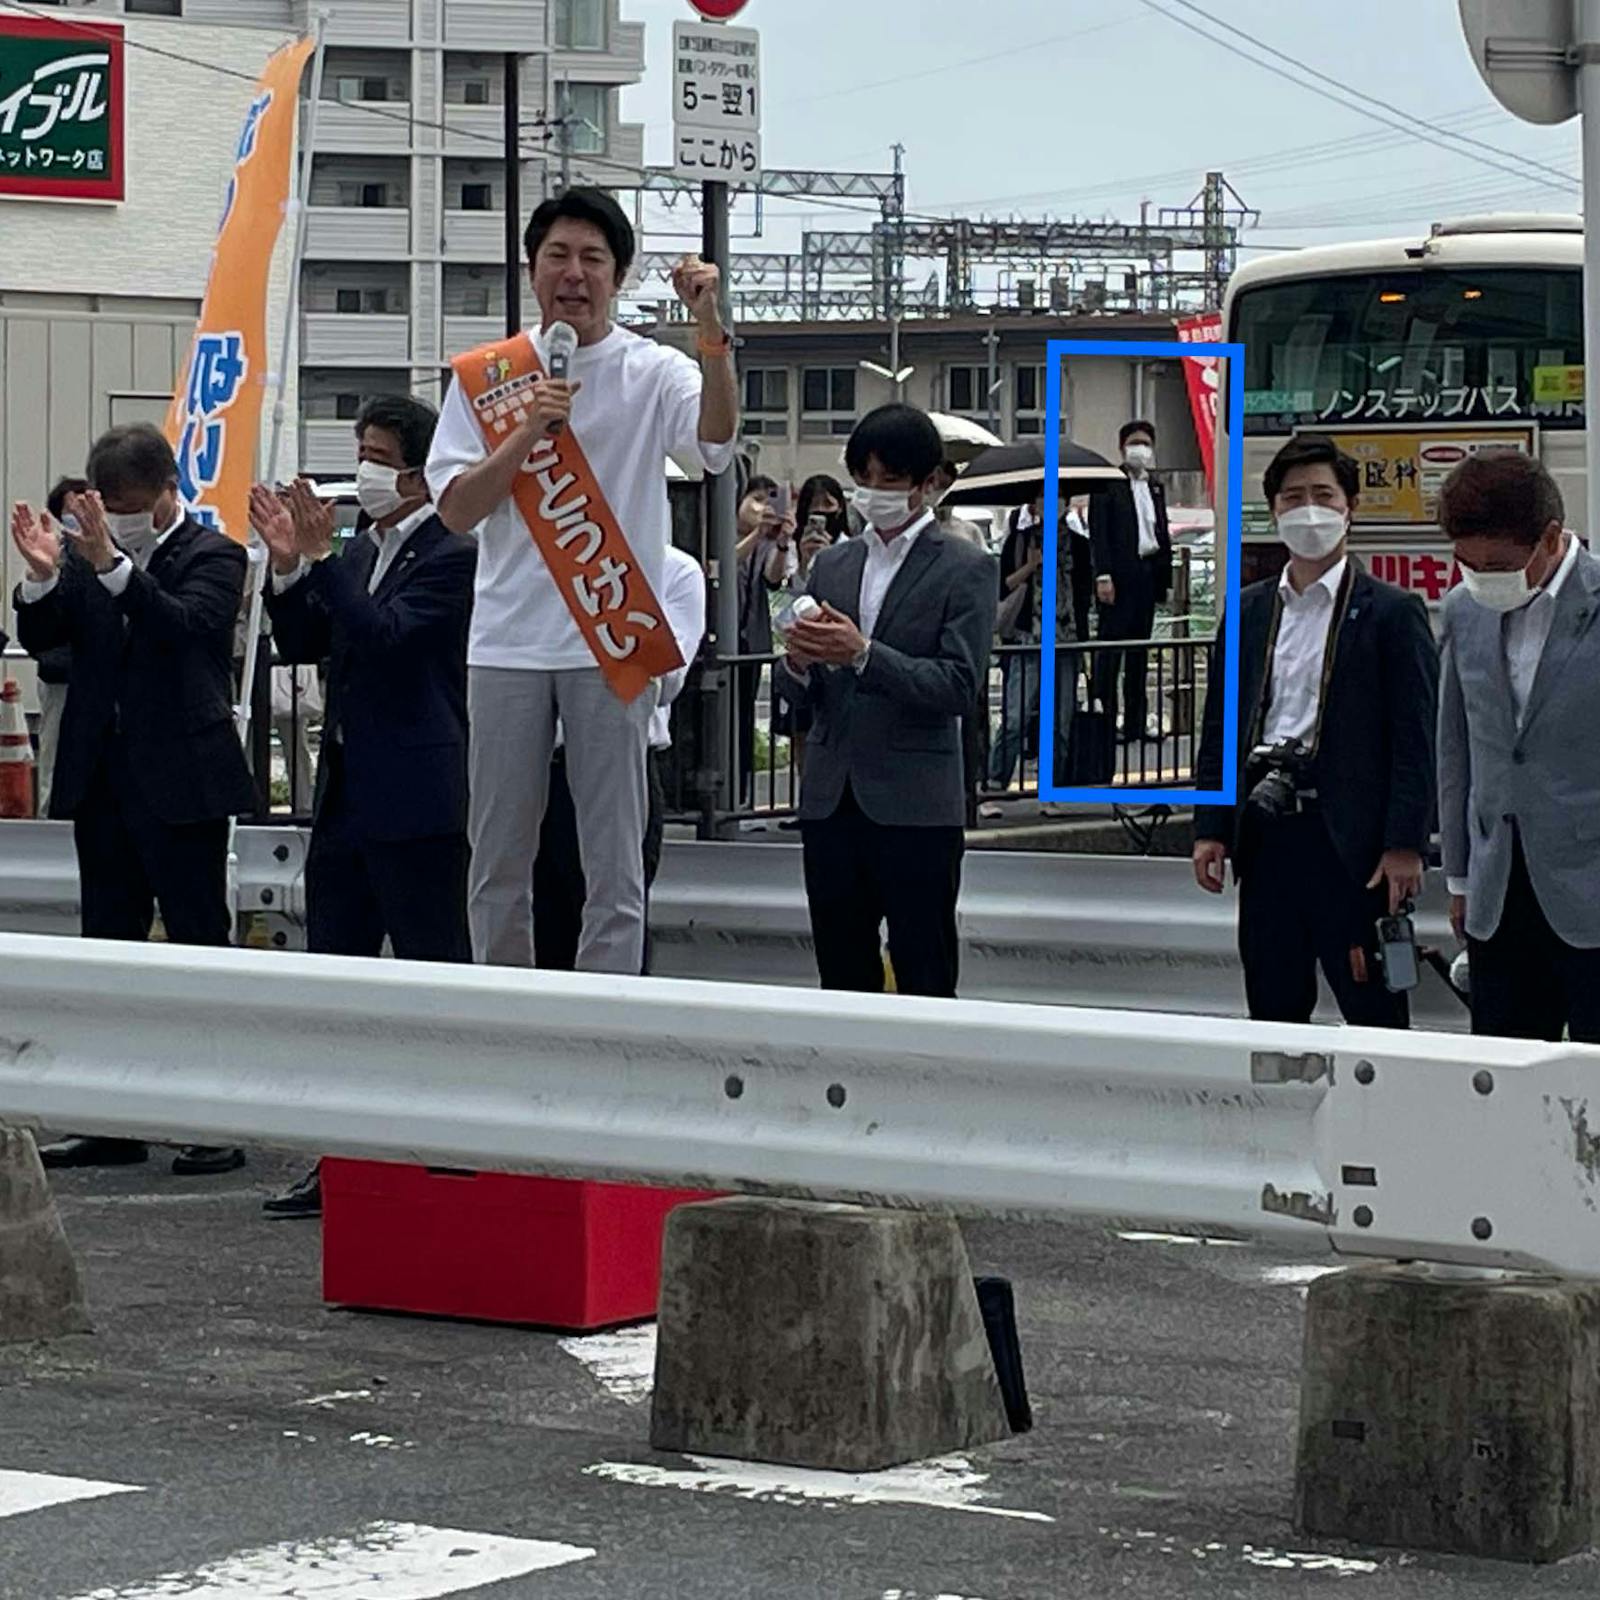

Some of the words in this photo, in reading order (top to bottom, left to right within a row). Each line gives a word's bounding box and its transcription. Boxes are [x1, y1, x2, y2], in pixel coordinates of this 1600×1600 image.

[680, 138, 756, 172] ここから
[1319, 386, 1522, 420] ノンステップバス
